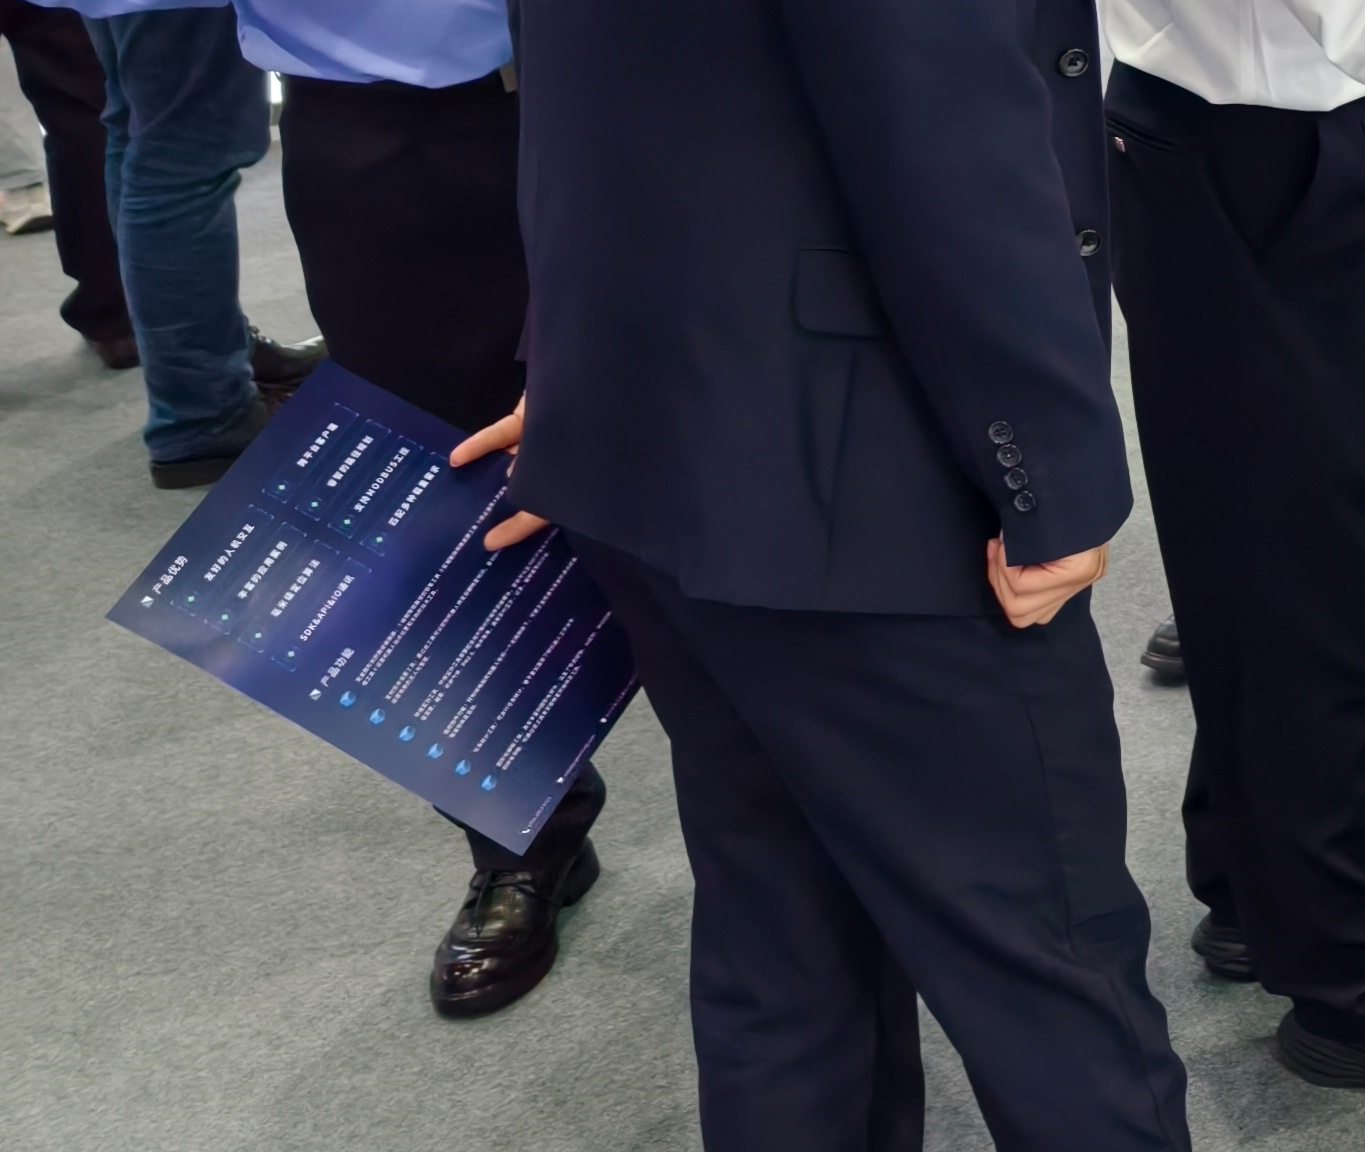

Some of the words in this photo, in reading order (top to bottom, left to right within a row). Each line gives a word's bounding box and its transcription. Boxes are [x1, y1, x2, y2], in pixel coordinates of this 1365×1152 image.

[152, 555, 188, 594] 产品优势
[320, 647, 354, 687] 产品功能
